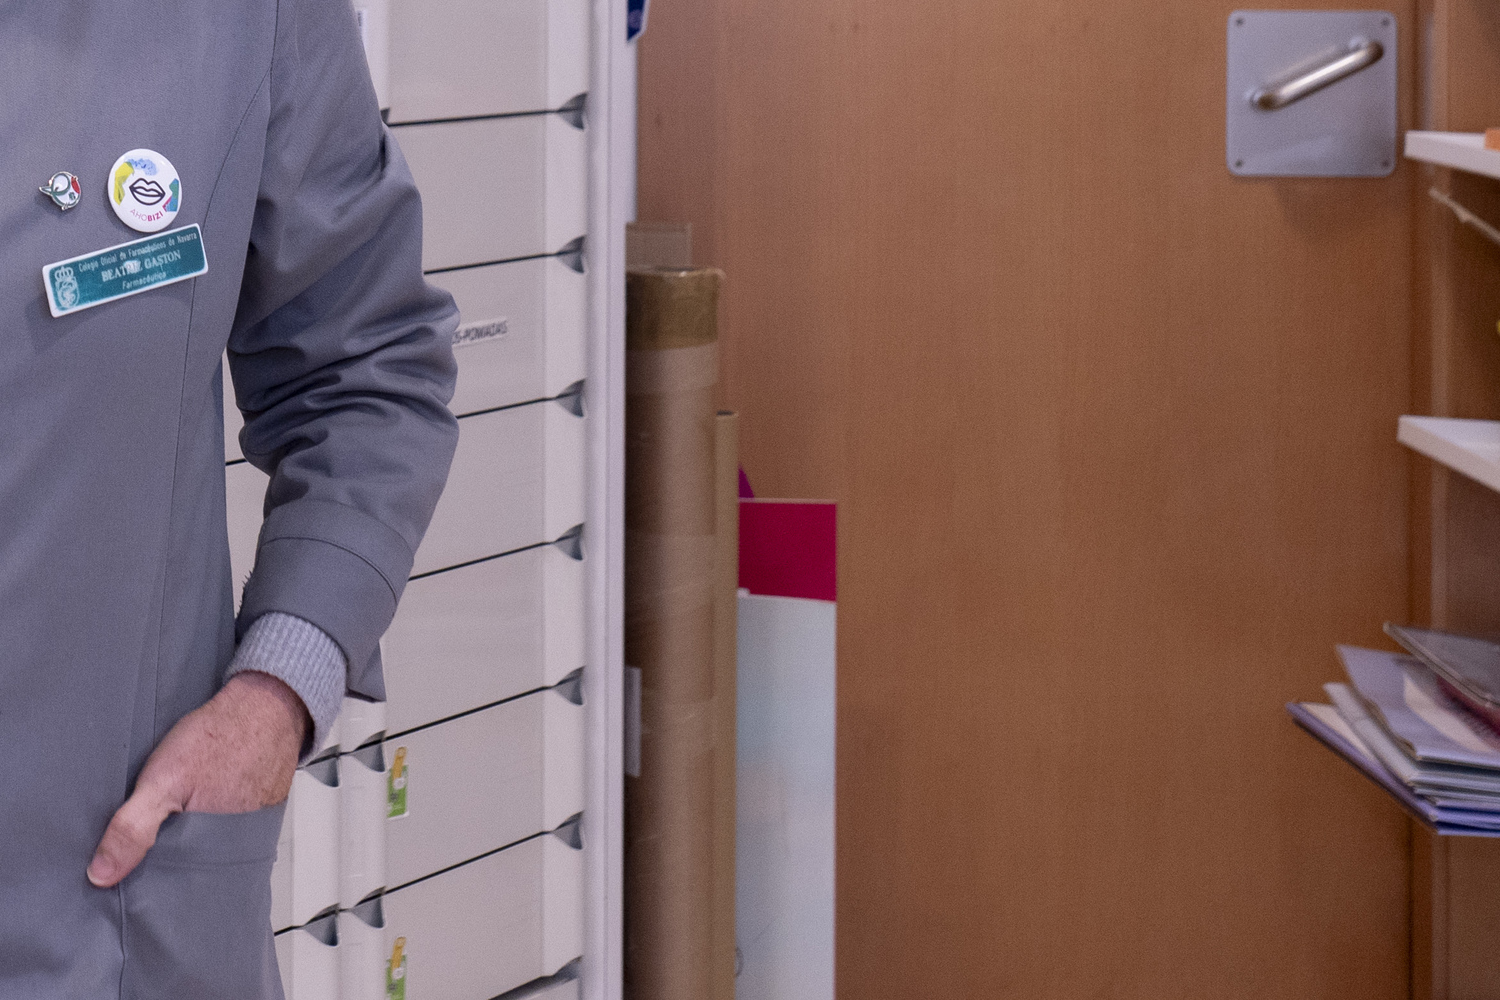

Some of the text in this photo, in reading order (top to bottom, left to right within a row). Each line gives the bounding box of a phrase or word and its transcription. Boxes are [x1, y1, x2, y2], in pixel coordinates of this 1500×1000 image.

[130, 209, 164, 221] AHOBIZI
[78, 260, 99, 272] Colegio
[168, 238, 176, 246] de
[177, 232, 198, 243] Navarra
